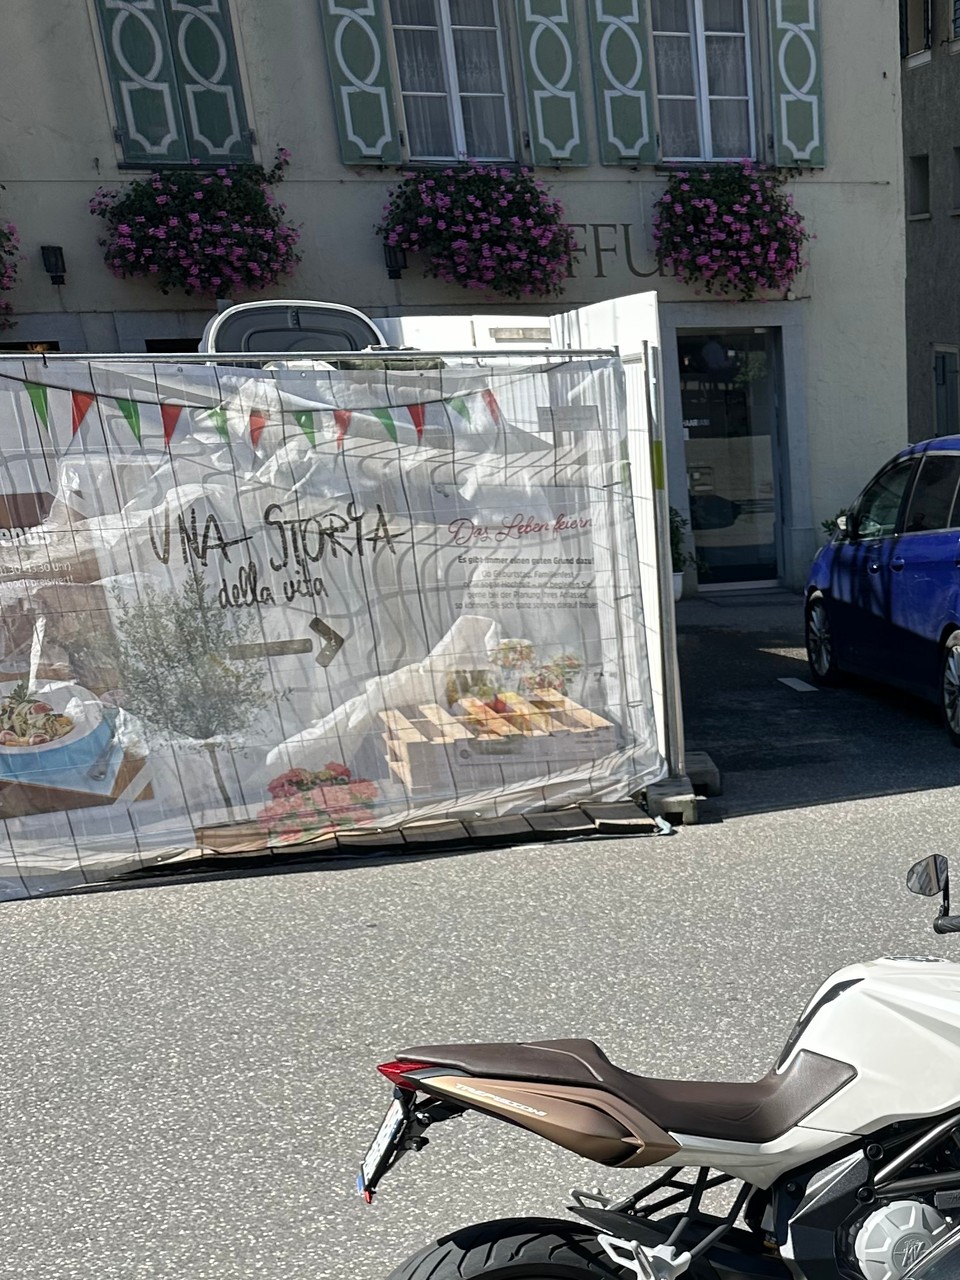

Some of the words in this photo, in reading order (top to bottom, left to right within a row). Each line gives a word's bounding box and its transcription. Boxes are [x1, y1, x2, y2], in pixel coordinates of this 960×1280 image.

[149, 499, 253, 567] UNA
[448, 517, 492, 545] Das
[495, 513, 549, 543] Leben
[457, 556, 467, 564] Es
[485, 556, 509, 564] immer
[510, 556, 530, 565] einen
[531, 556, 552, 566] guten
[553, 556, 574, 565] Grund
[218, 560, 276, 610] della
[283, 560, 329, 602] vita
